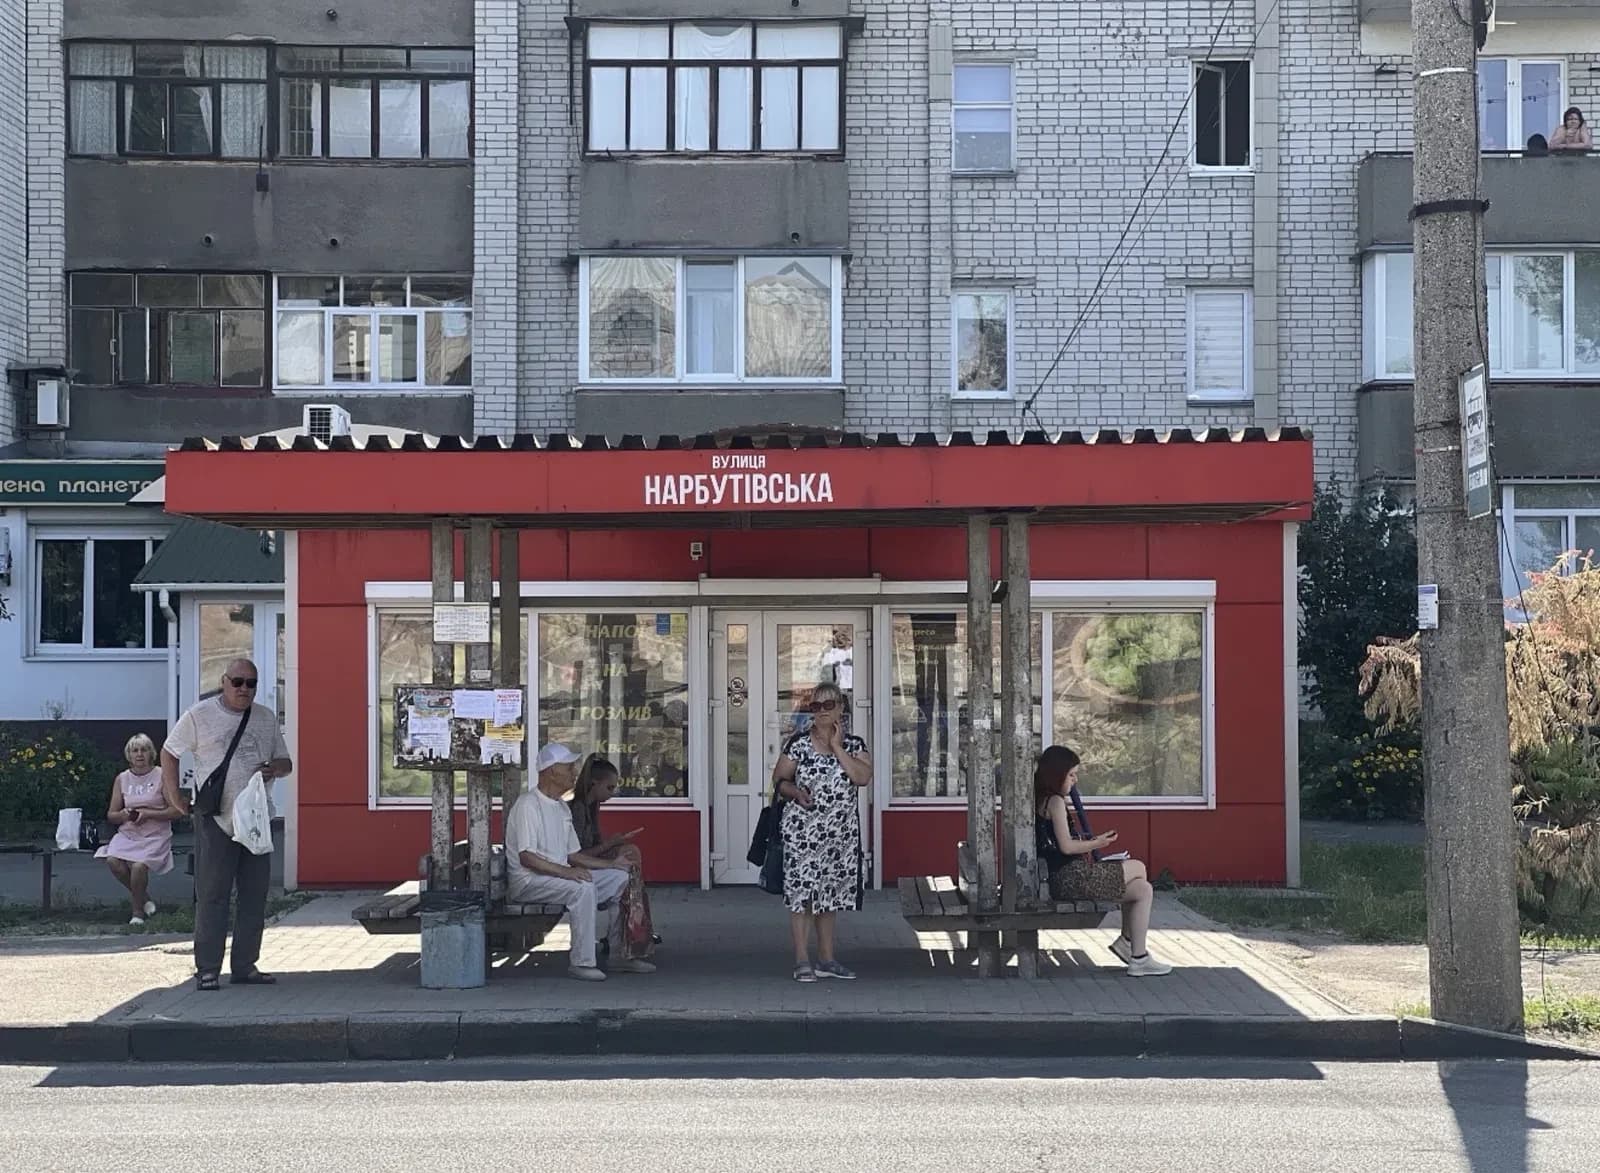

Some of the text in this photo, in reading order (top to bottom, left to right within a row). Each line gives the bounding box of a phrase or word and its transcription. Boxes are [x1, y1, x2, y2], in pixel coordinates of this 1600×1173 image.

[712, 455, 766, 469] ВУЛИЦЯ
[0, 480, 45, 493] ена
[644, 473, 833, 505] НАРБУТІВСЬКА
[584, 624, 645, 638] НАПО
[603, 663, 628, 677] НА
[580, 705, 652, 720] РОЗЛИВ
[596, 740, 638, 753] Квас
[616, 777, 656, 788] онад
